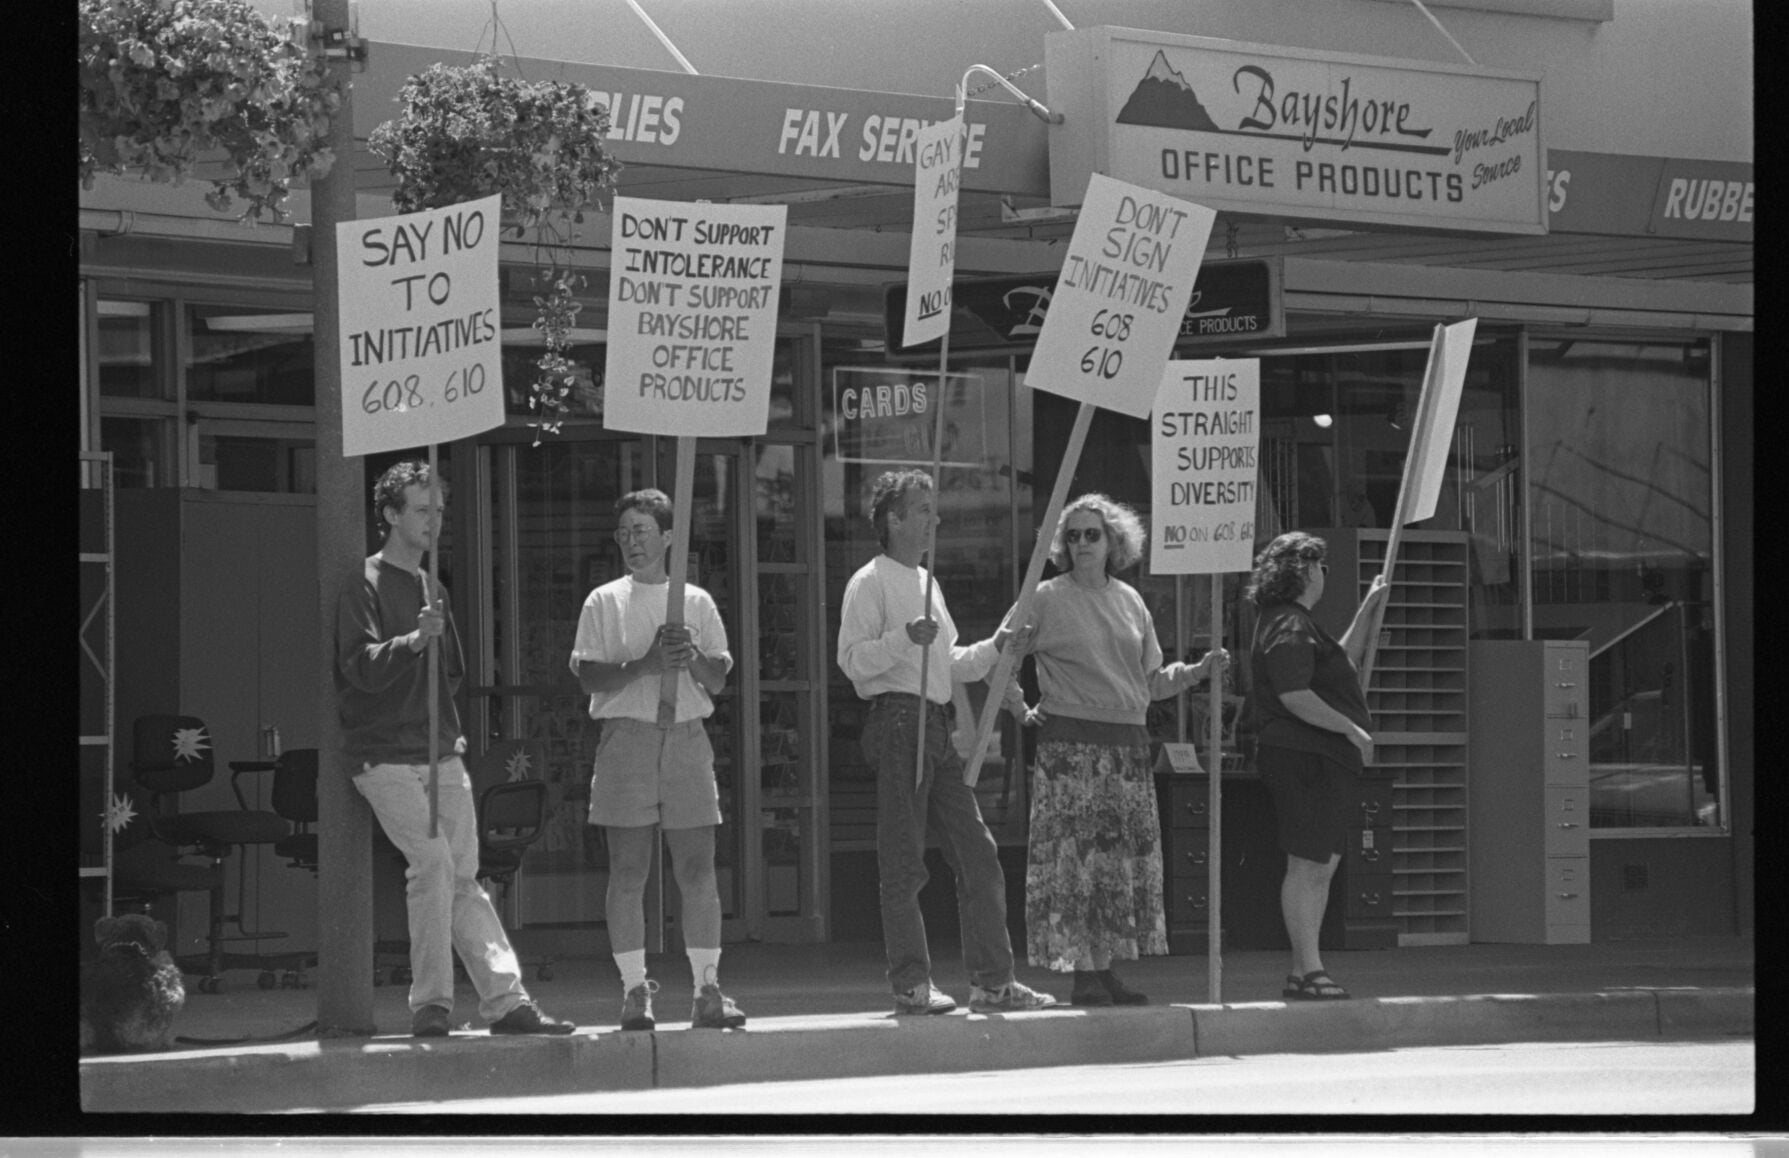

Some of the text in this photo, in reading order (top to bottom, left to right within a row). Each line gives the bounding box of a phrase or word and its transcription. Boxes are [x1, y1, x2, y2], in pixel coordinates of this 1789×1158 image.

[1232, 64, 1433, 152] Bayshore
[777, 108, 848, 159] FAX
[858, 113, 987, 169] SERE
[1454, 100, 1537, 166] Your Local
[1161, 148, 1464, 203] OFFICE PRODUCTS
[1471, 153, 1522, 190] Source
[621, 212, 775, 246] DON'T SUPPORT
[1115, 195, 1189, 240] DON'T
[361, 210, 485, 268] SAY NO
[1102, 226, 1172, 273] SIGN
[625, 247, 772, 279] INTOLERANCE
[391, 271, 451, 312] TO
[617, 276, 773, 309] DON'T SUPPORT
[1063, 254, 1174, 314] INITIATIVES
[918, 290, 942, 320] NO
[348, 308, 496, 367] INITIATIVES
[637, 311, 750, 341] BAYSHORE
[1090, 308, 1135, 342] 608
[1199, 315, 1259, 335] PRODUCTS
[652, 344, 735, 372] OFFICE
[1079, 345, 1123, 380] 610
[444, 362, 486, 403] 610
[639, 372, 747, 403] PRODUCTS
[1182, 373, 1238, 402] THIS
[841, 382, 928, 420] CARDS
[1161, 410, 1254, 438] STRAIGHT
[1177, 446, 1255, 471] SUPPORTS
[1170, 481, 1255, 506] DIVERSITY
[1163, 524, 1187, 548] NO
[1189, 526, 1209, 542] ON
